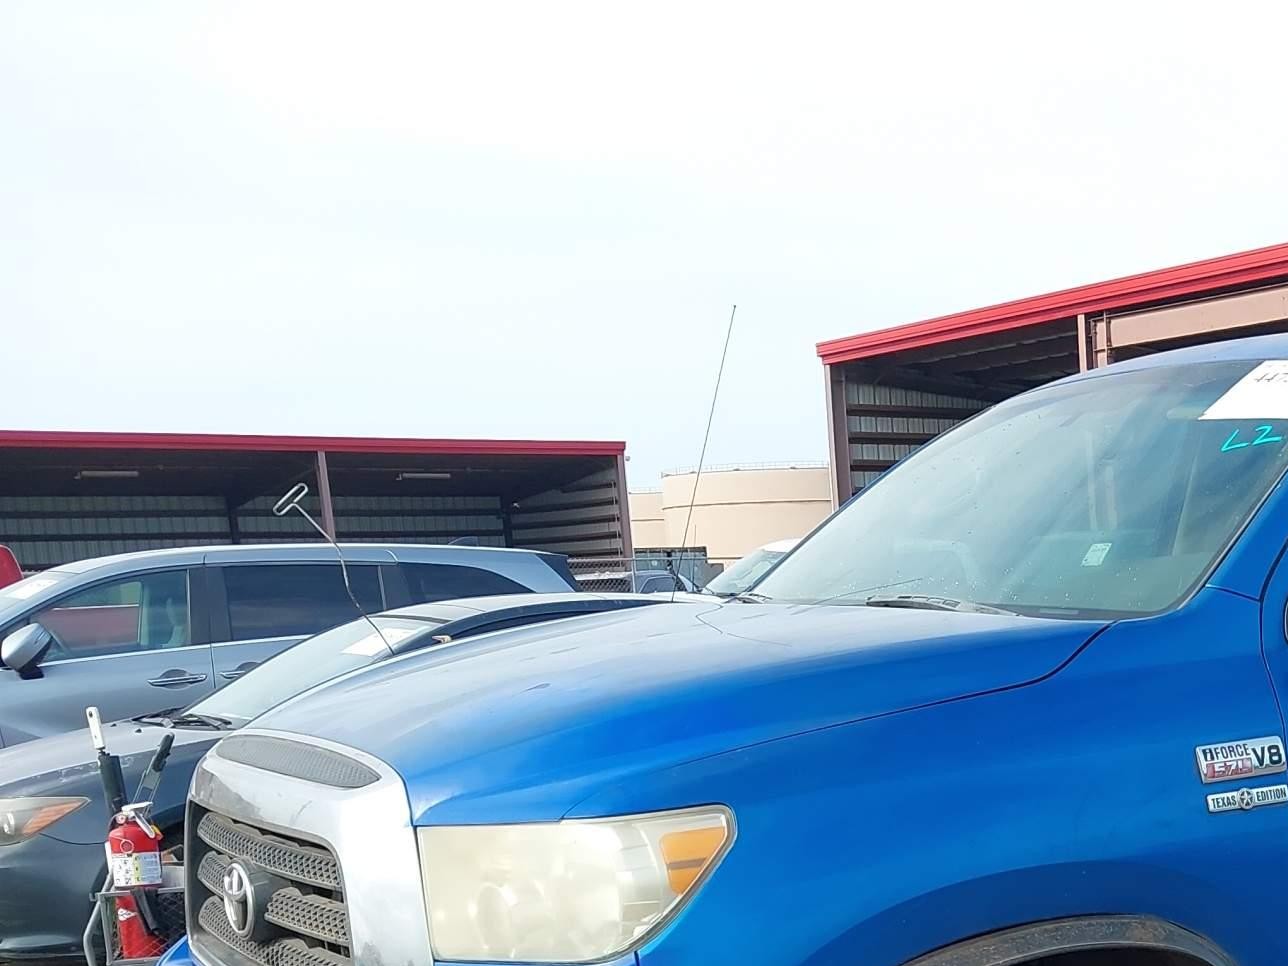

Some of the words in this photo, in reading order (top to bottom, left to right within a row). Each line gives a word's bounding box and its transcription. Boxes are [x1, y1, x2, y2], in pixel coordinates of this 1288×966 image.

[1251, 744, 1283, 768] V8
[1211, 795, 1237, 809] TEXAS
[1256, 787, 1287, 802] EDITION
